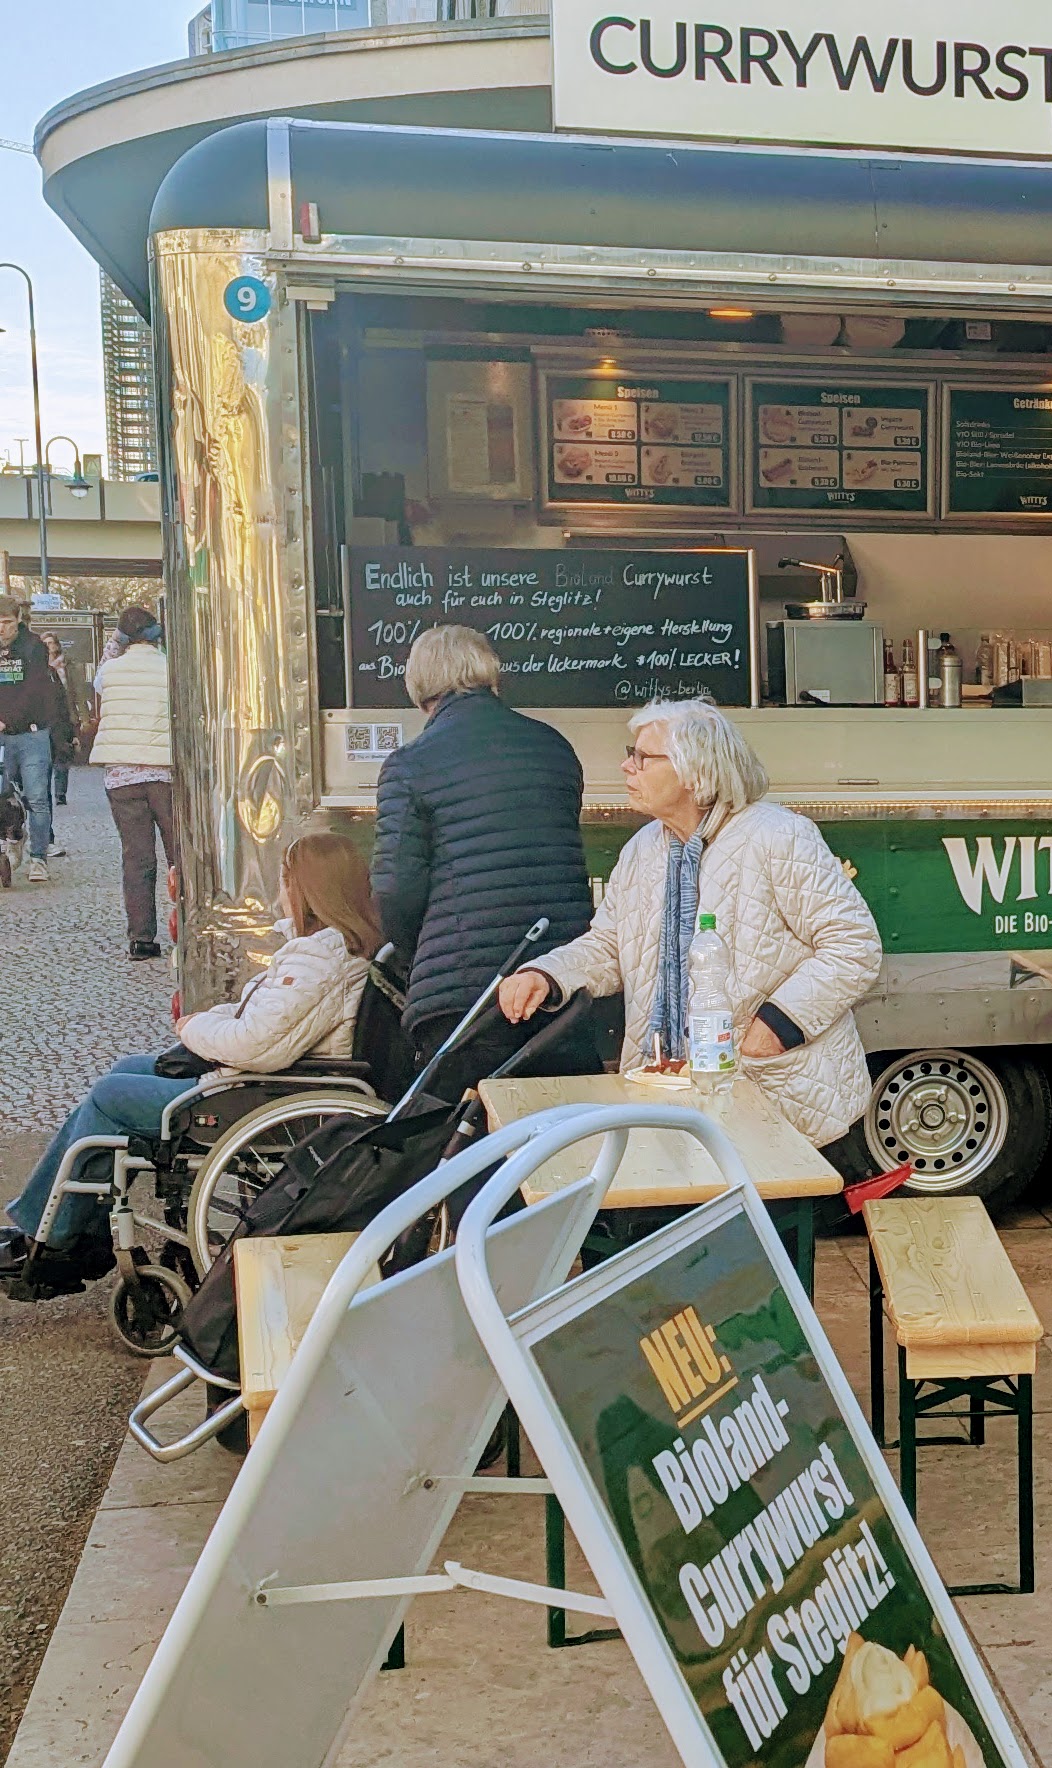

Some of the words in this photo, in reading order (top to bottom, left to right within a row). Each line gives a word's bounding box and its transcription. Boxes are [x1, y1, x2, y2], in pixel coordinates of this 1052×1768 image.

[237, 286, 257, 312] 9
[365, 562, 434, 590] Endlich
[448, 565, 473, 587] ist
[481, 572, 540, 588] unsere
[622, 563, 713, 600] Currywurst
[395, 590, 432, 607] auch
[441, 589, 466, 614] für
[470, 591, 503, 607] euch
[509, 592, 525, 605] in
[530, 588, 602, 613] Steglitz!
[660, 618, 733, 644] Herstellung
[522, 653, 544, 674] der
[547, 653, 628, 674] Uckermark
[994, 913, 1018, 934] DIE
[639, 1305, 731, 1414] NEU:
[651, 1374, 790, 1535] Bioland-
[677, 1441, 855, 1649] Currywurst
[722, 1645, 789, 1753] für
[766, 1519, 898, 1696] Steglitz!
